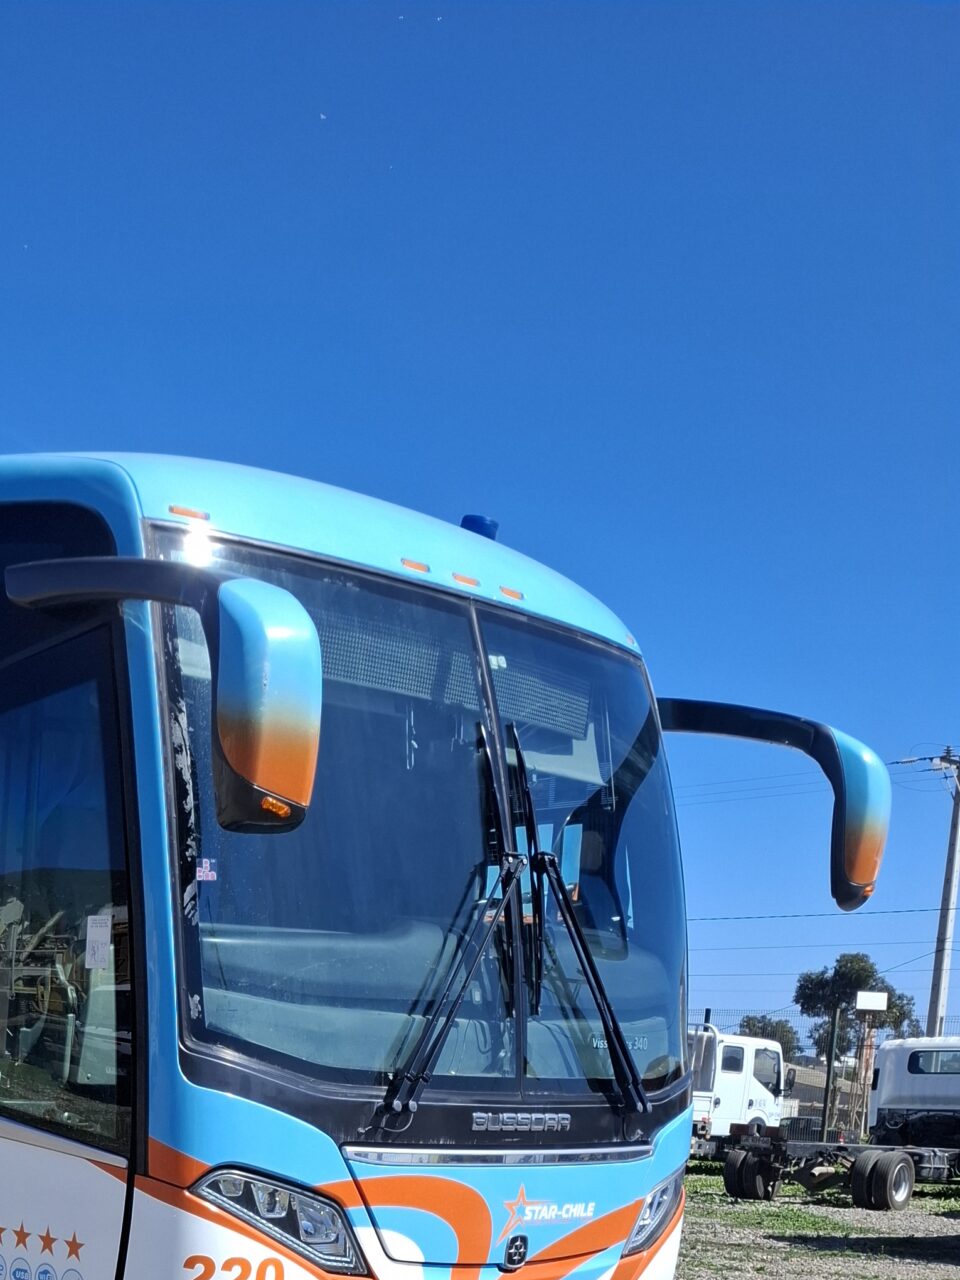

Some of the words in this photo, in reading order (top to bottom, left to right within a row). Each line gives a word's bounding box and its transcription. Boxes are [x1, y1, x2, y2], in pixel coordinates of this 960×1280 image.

[592, 1037, 609, 1049] Viss
[633, 1036, 648, 1051] 340
[472, 1112, 572, 1132] BUSSCAR
[523, 1202, 596, 1221] STAR-CHILE
[15, 1270, 32, 1280] USB
